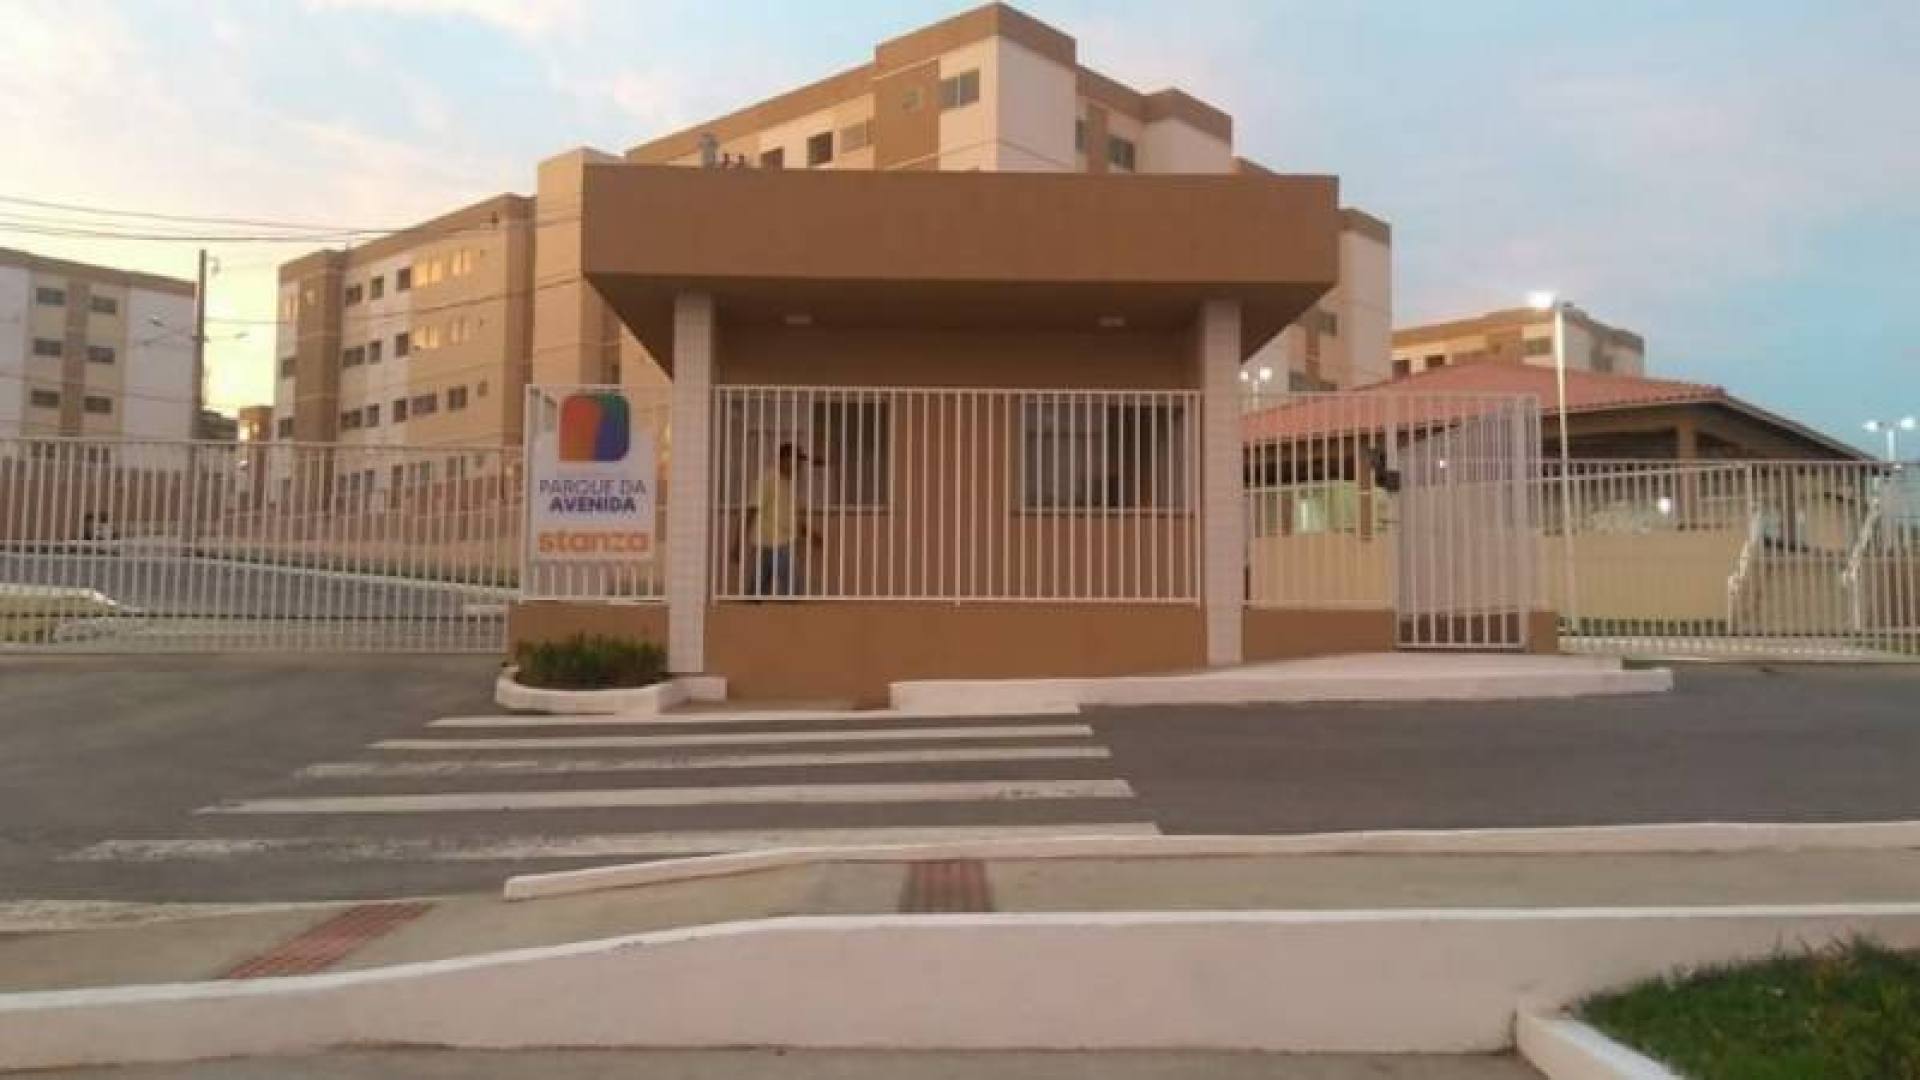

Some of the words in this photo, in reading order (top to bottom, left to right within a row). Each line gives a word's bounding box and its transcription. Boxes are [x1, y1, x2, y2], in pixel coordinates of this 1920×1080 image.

[539, 479, 613, 496] PARQUE
[619, 479, 646, 495] DA
[549, 496, 637, 513] AVENIDA
[538, 529, 649, 553] stanza
